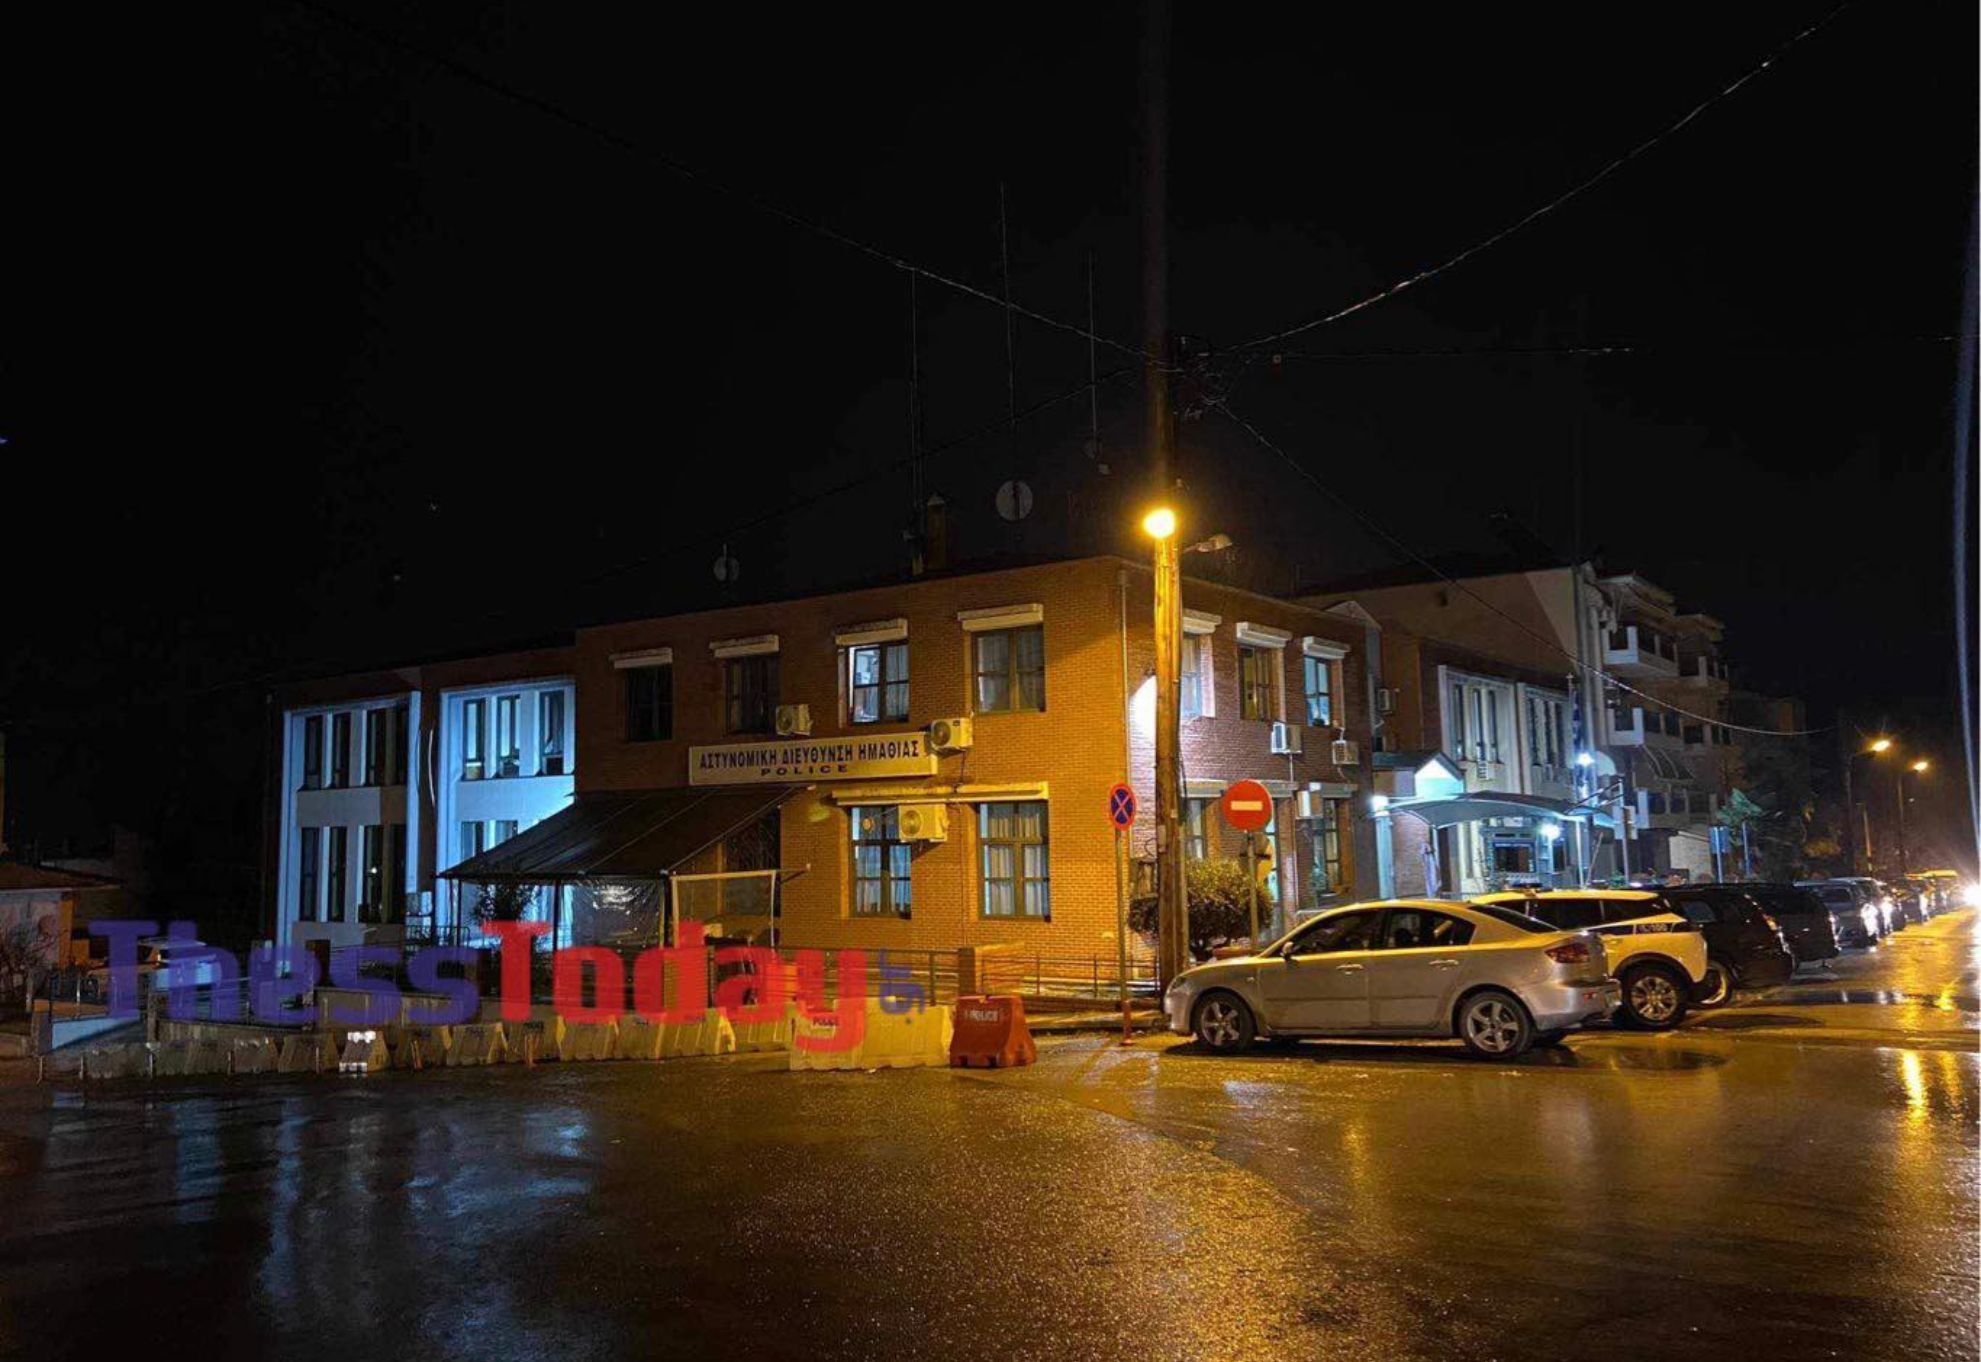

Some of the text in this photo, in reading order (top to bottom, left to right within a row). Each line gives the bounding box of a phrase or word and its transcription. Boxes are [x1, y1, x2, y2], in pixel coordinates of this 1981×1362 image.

[700, 740, 919, 769] ΑΣΤΥΝΟΜΙΚΗ ΔΙΕΥΘΥΝΣΗ ΗΜΑΘΙΑΣ
[761, 764, 848, 777] POLICE
